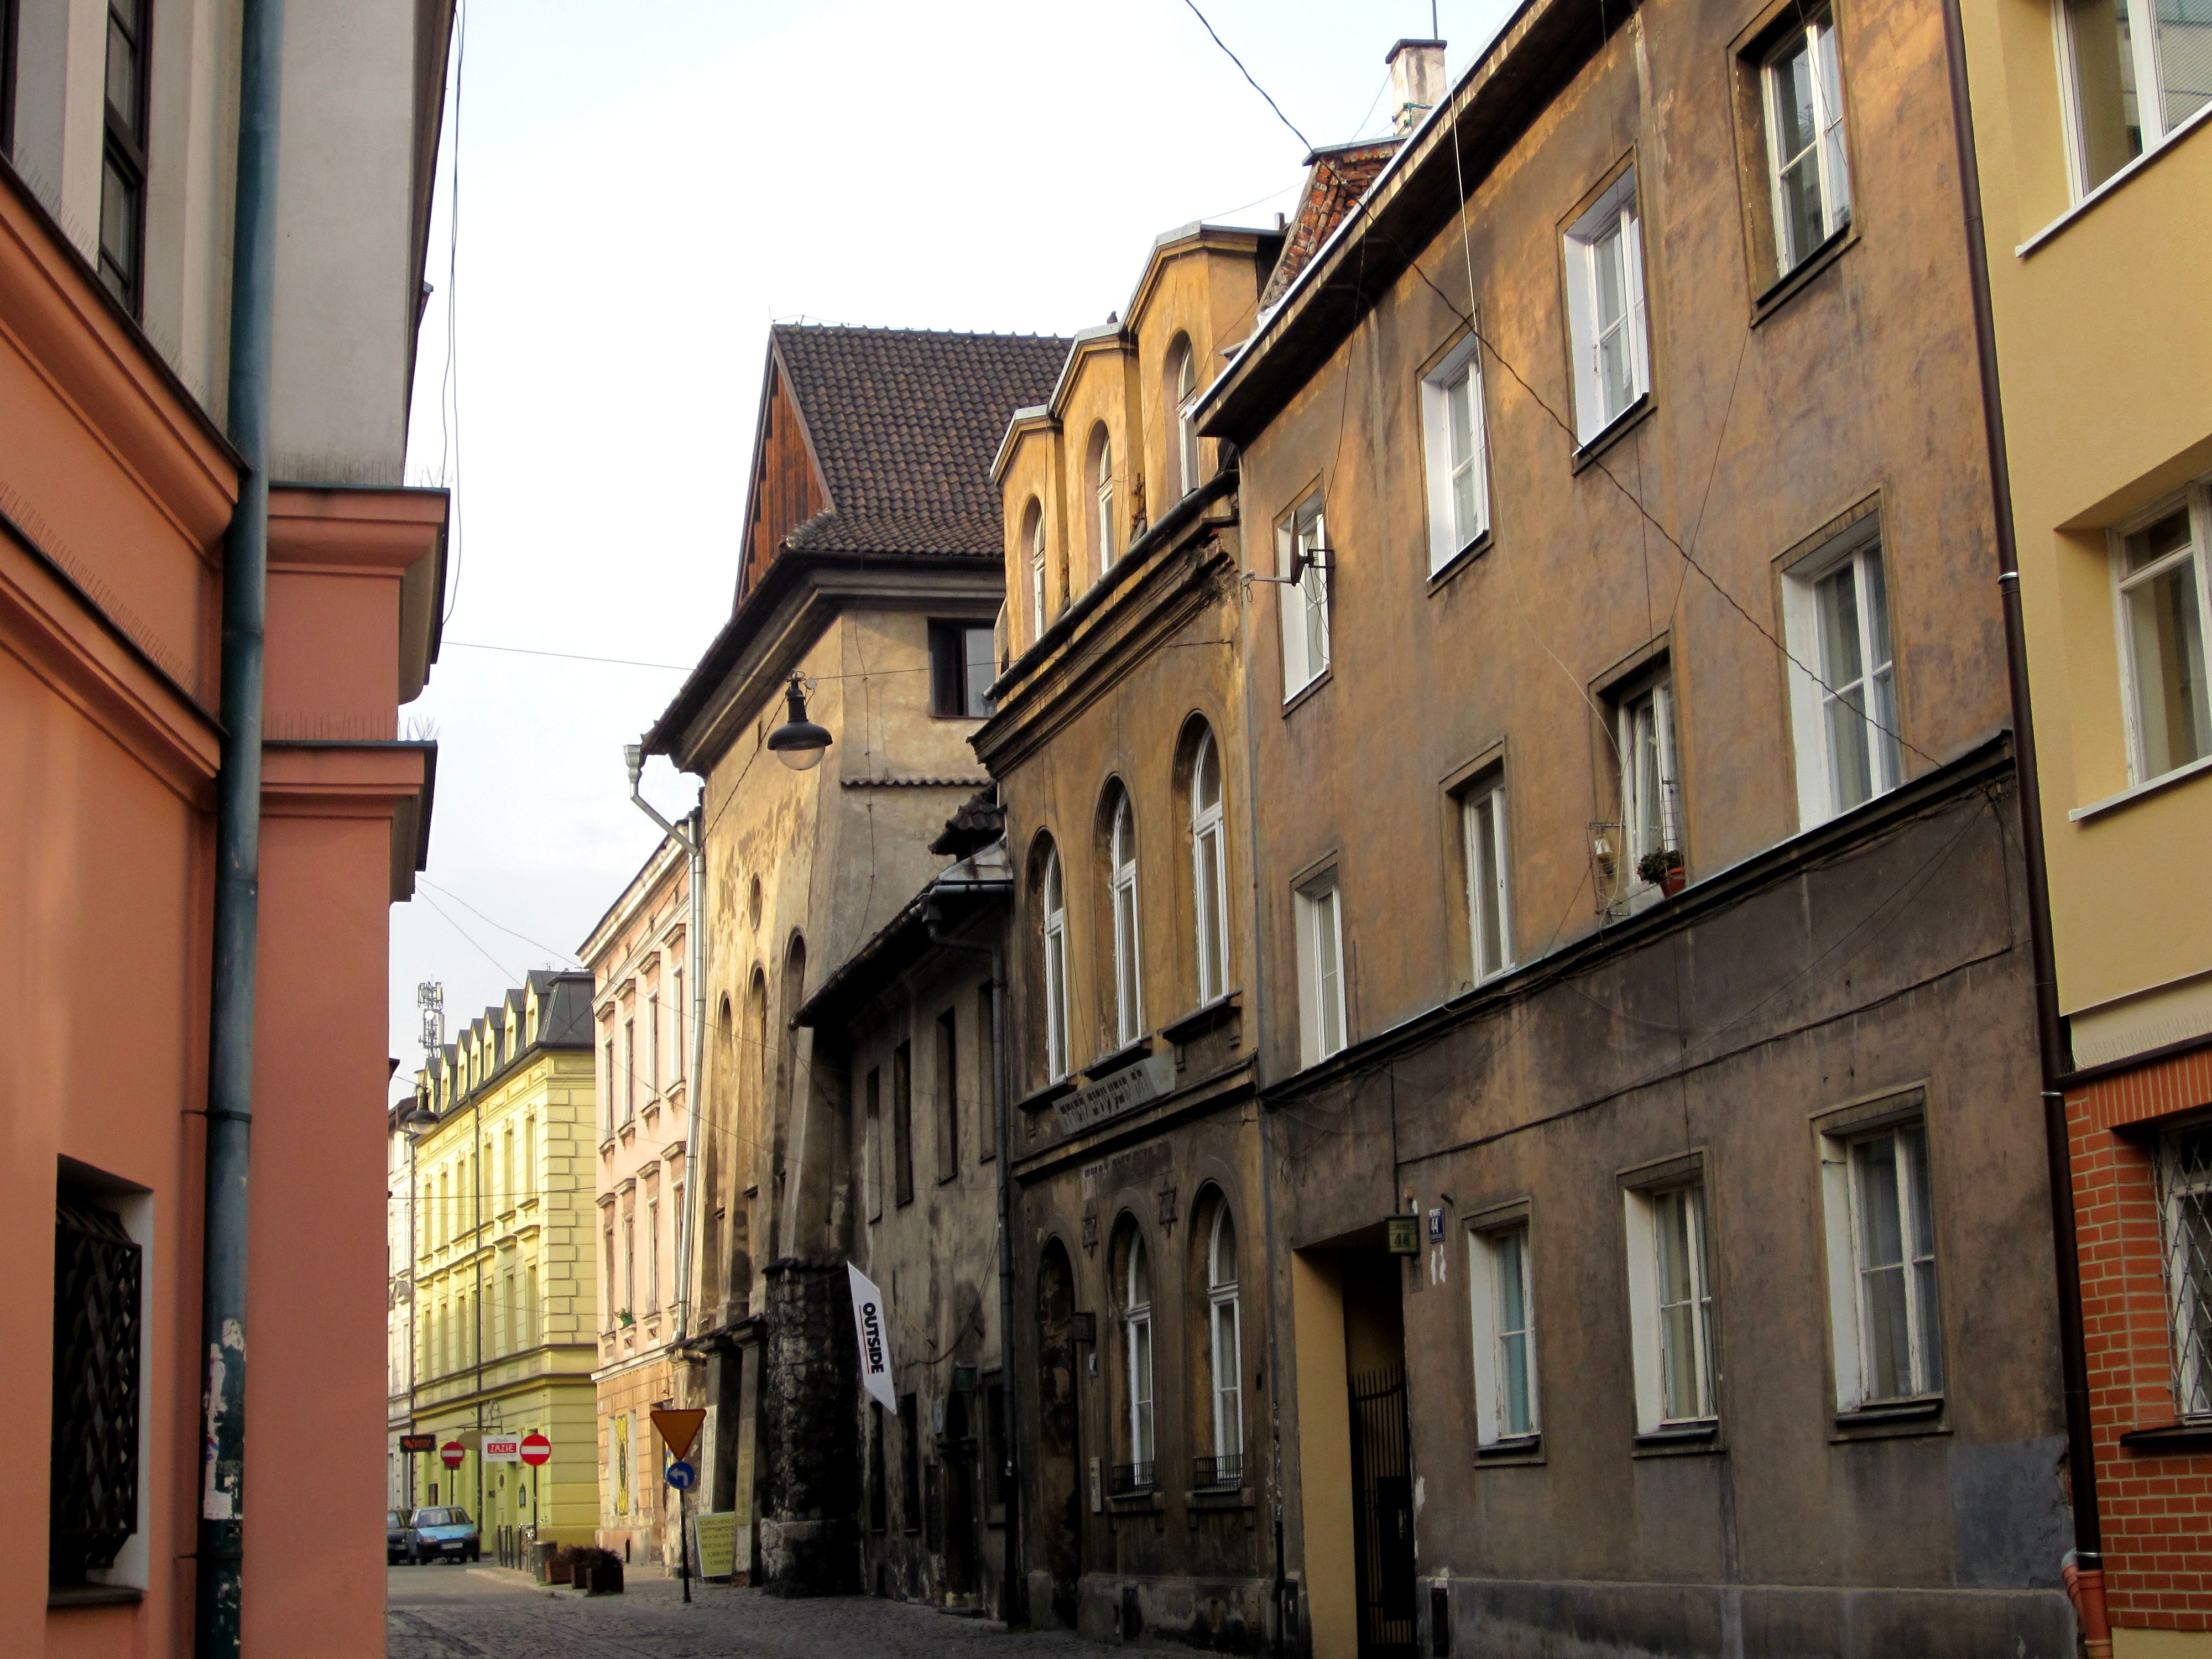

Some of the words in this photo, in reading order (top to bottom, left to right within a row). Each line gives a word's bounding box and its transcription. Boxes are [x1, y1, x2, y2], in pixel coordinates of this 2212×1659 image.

[1431, 1217, 1438, 1233] 44
[863, 1302, 884, 1374] OUTSIDE
[490, 1444, 514, 1453] ZAZIE
